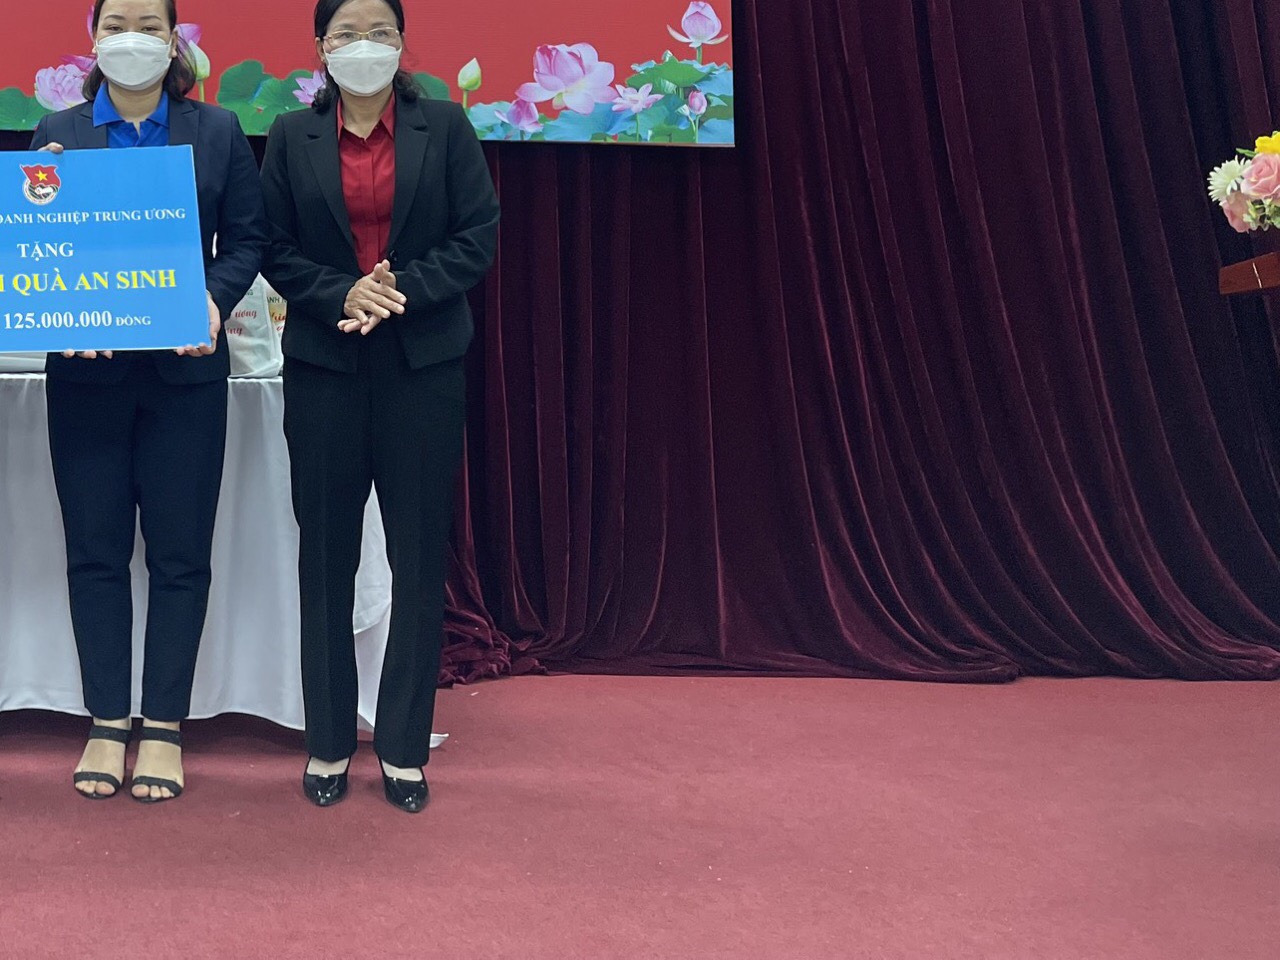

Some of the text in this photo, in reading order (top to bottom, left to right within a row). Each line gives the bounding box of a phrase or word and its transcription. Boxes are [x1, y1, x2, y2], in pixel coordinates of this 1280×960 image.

[36, 211, 90, 225] NGHIỆP
[93, 210, 141, 222] TRUNG
[144, 207, 186, 220] ƯƠNG
[16, 242, 74, 262] TẶNG
[12, 267, 68, 297] QUÀ
[73, 271, 109, 291] AN
[116, 269, 177, 290] SINH
[3, 310, 113, 330] 125.000.000
